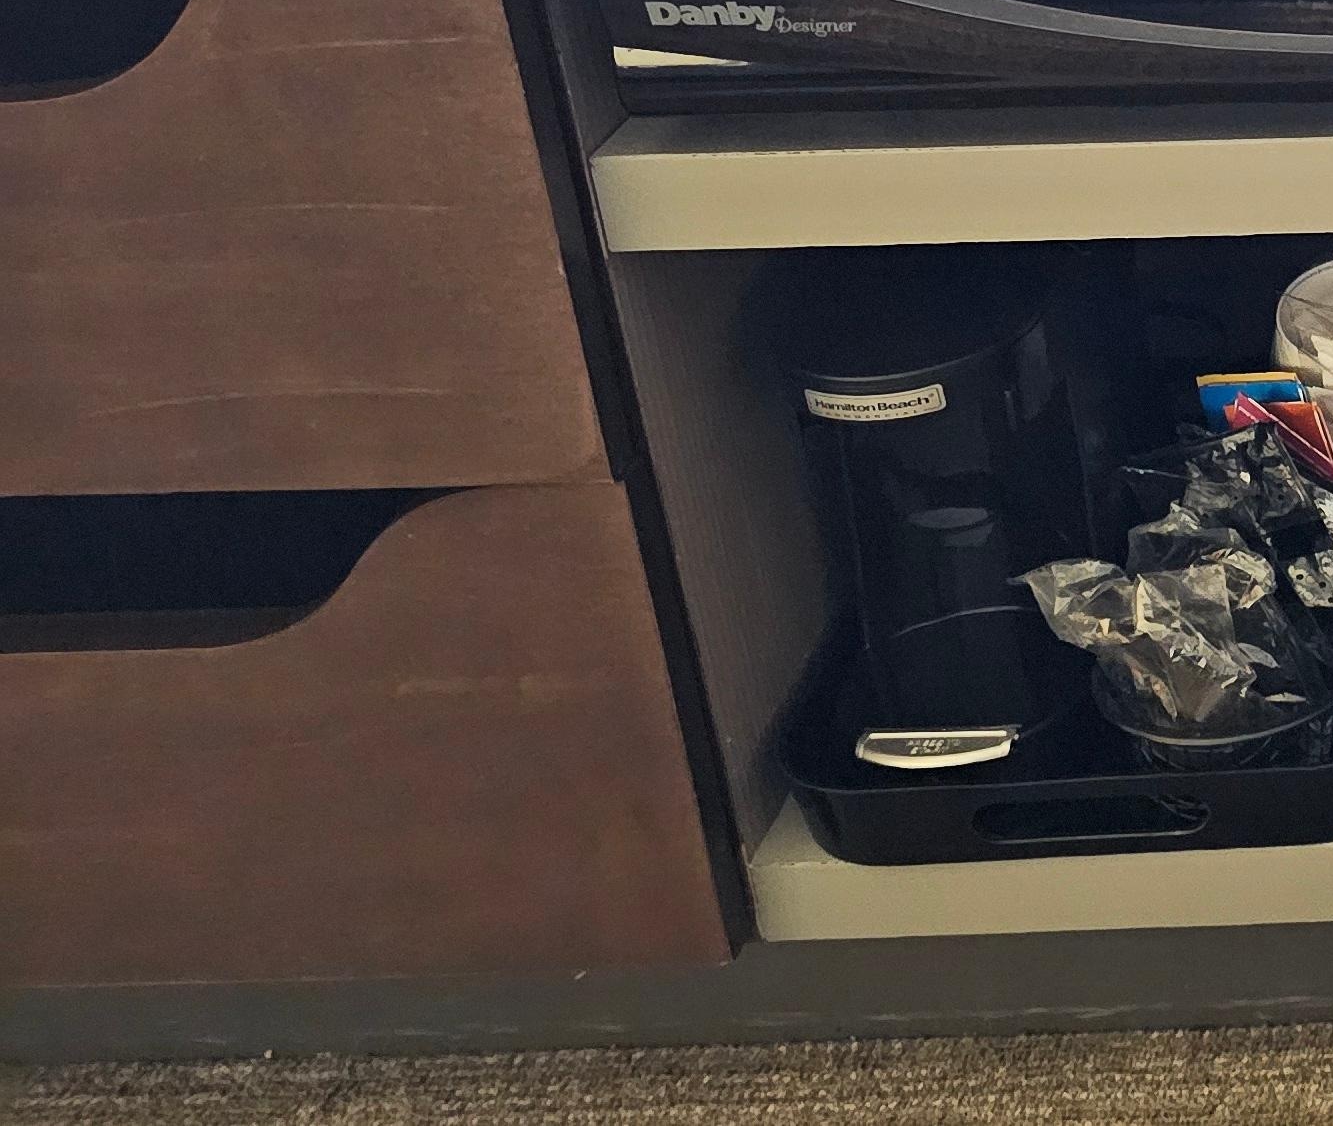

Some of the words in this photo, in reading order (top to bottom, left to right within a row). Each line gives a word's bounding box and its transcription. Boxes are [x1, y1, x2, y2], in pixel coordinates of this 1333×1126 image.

[644, 1, 777, 31] Danby
[775, 16, 857, 38] Designer
[814, 398, 876, 412] Hamilton
[877, 396, 931, 411] Beach
